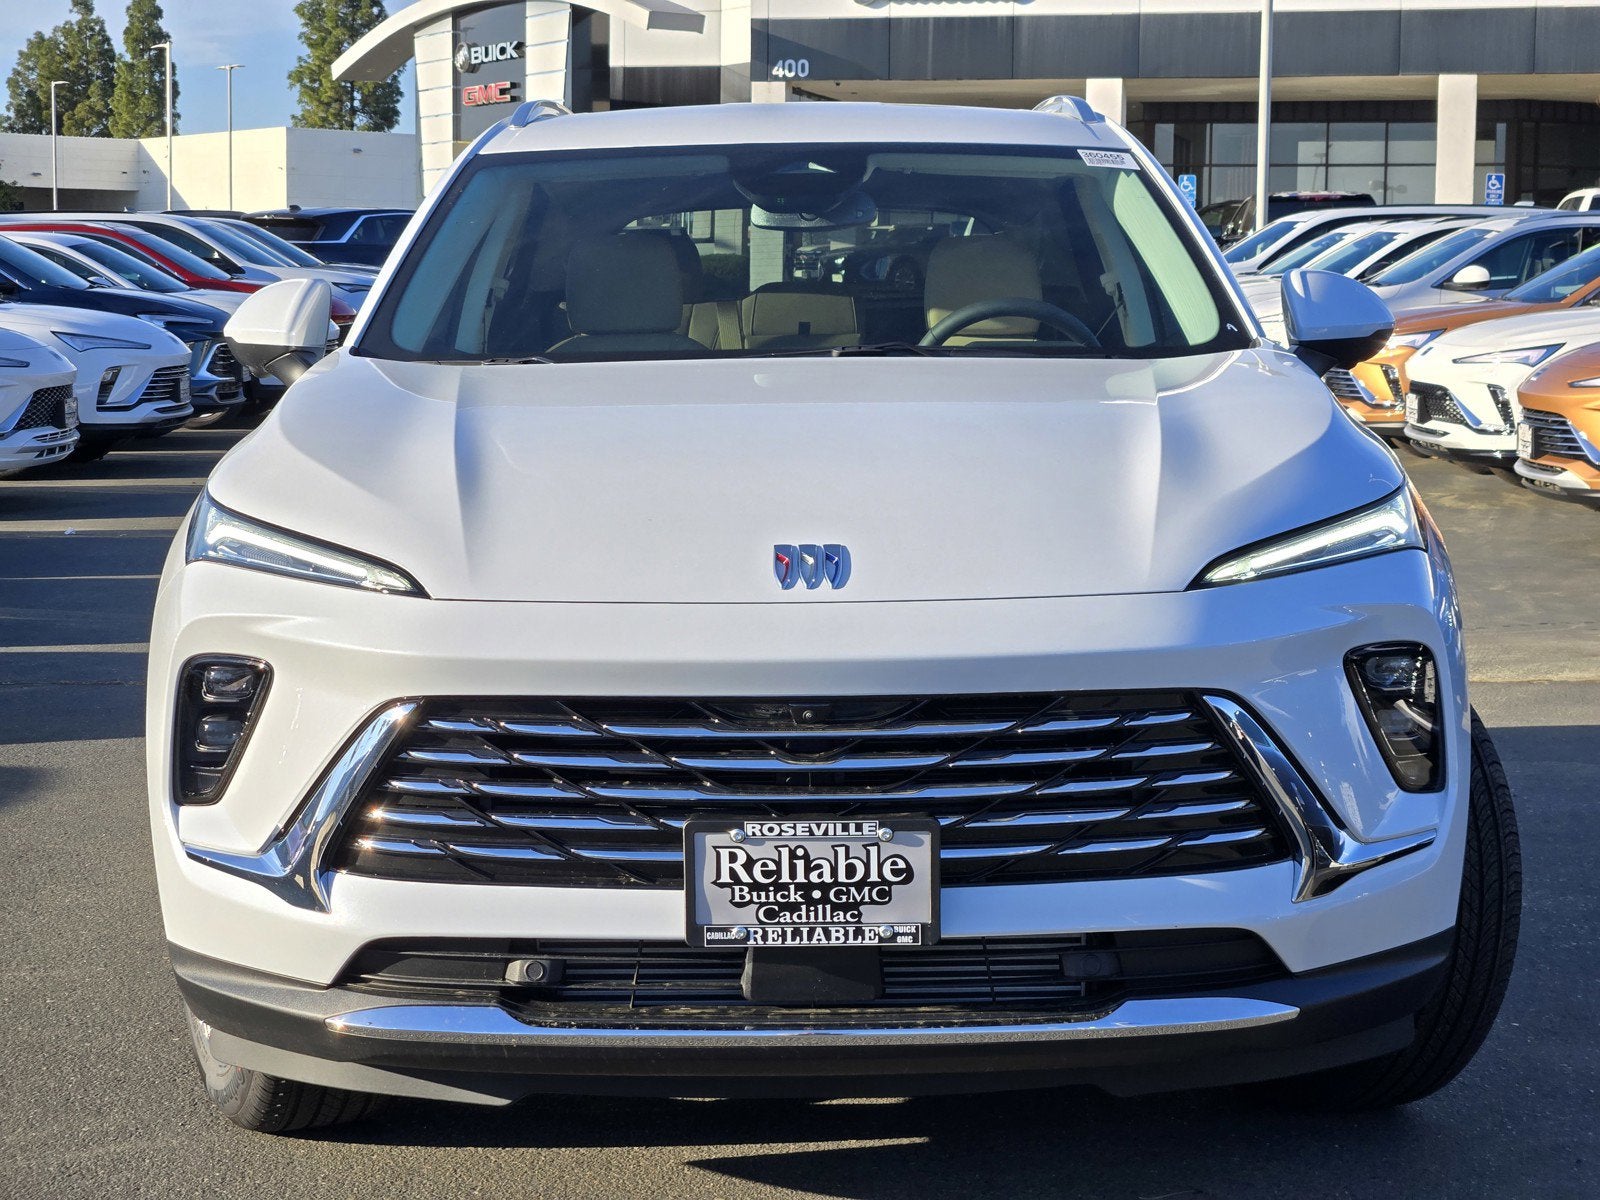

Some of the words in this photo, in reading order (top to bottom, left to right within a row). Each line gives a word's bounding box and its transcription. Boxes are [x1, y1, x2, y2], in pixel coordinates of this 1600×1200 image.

[470, 40, 518, 64] BUICK
[771, 58, 809, 78] 400
[463, 81, 511, 106] GMC
[746, 822, 878, 836] ROSEVILLE
[715, 845, 907, 884] Reliable
[731, 885, 805, 903] Buick
[829, 886, 892, 902] GMC
[757, 904, 859, 923] Cadillac
[746, 926, 879, 945] RELIABLE
[893, 925, 916, 934] BUICK
[896, 935, 913, 943] GMC
